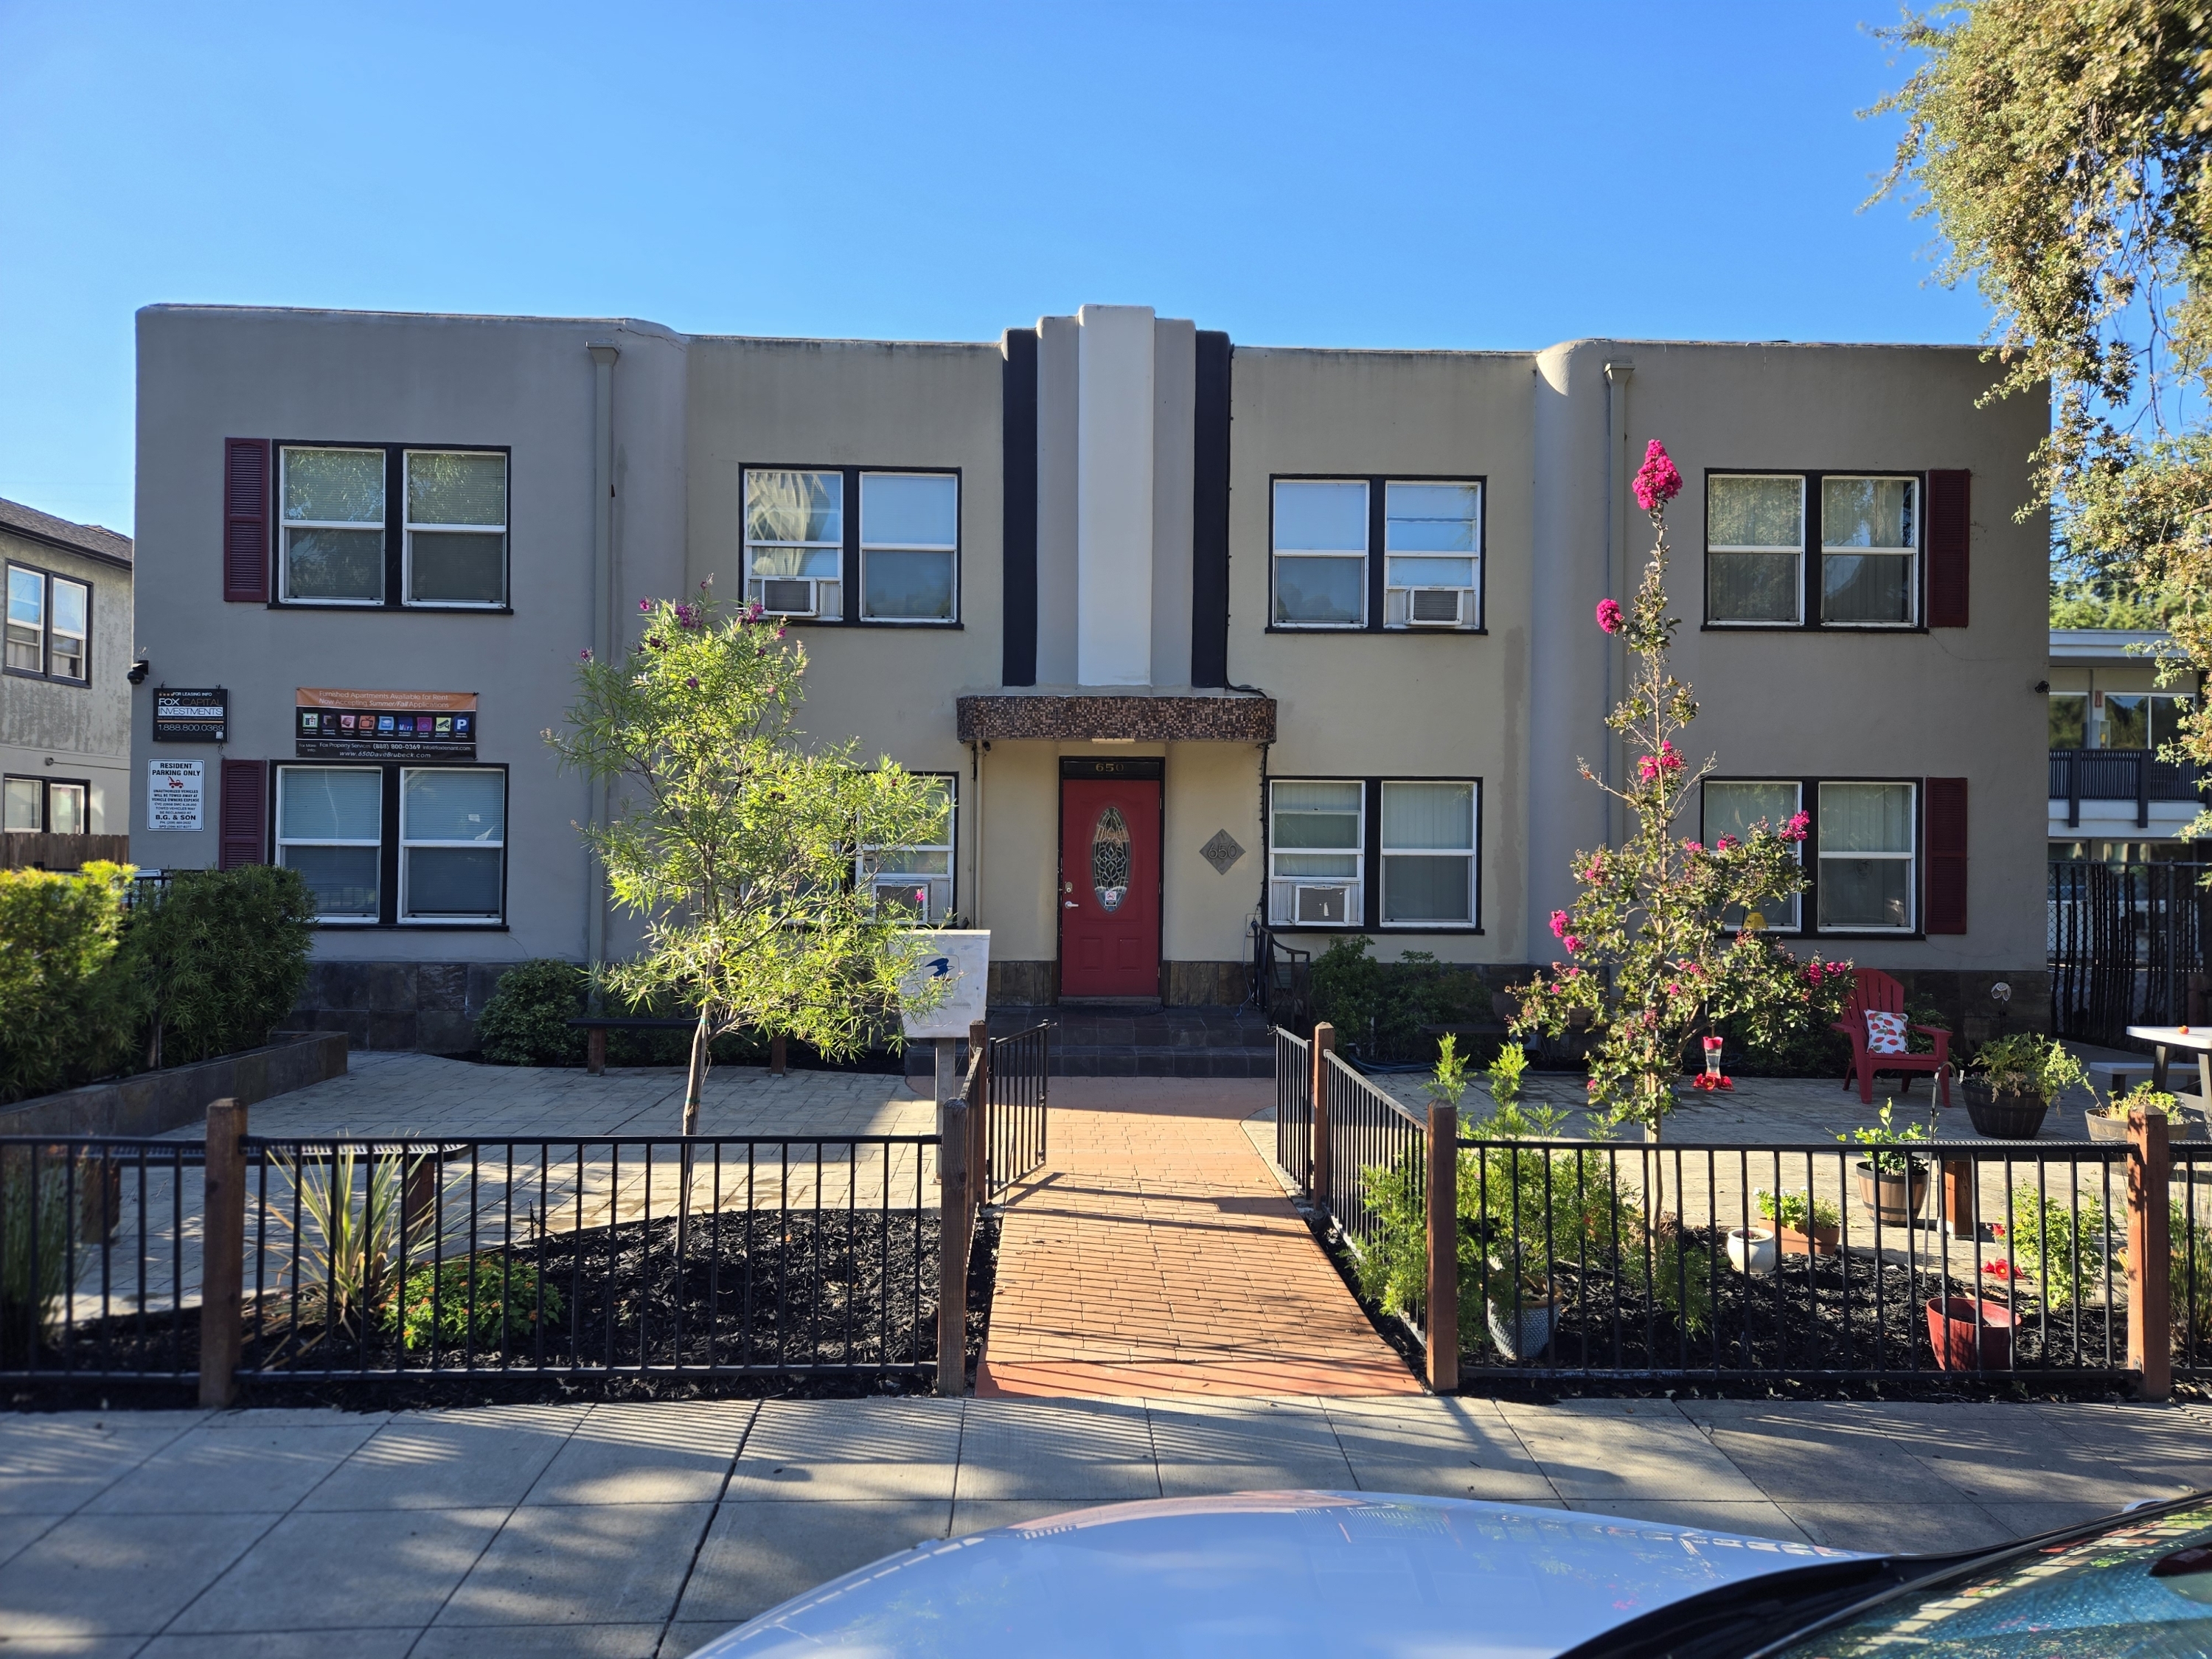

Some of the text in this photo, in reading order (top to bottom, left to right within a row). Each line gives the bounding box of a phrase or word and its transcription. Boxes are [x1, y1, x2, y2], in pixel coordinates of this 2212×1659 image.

[182, 698, 223, 706] CAPITAL
[457, 719, 467, 730] P
[1096, 763, 1124, 772] 650
[1208, 844, 1238, 859] 650
